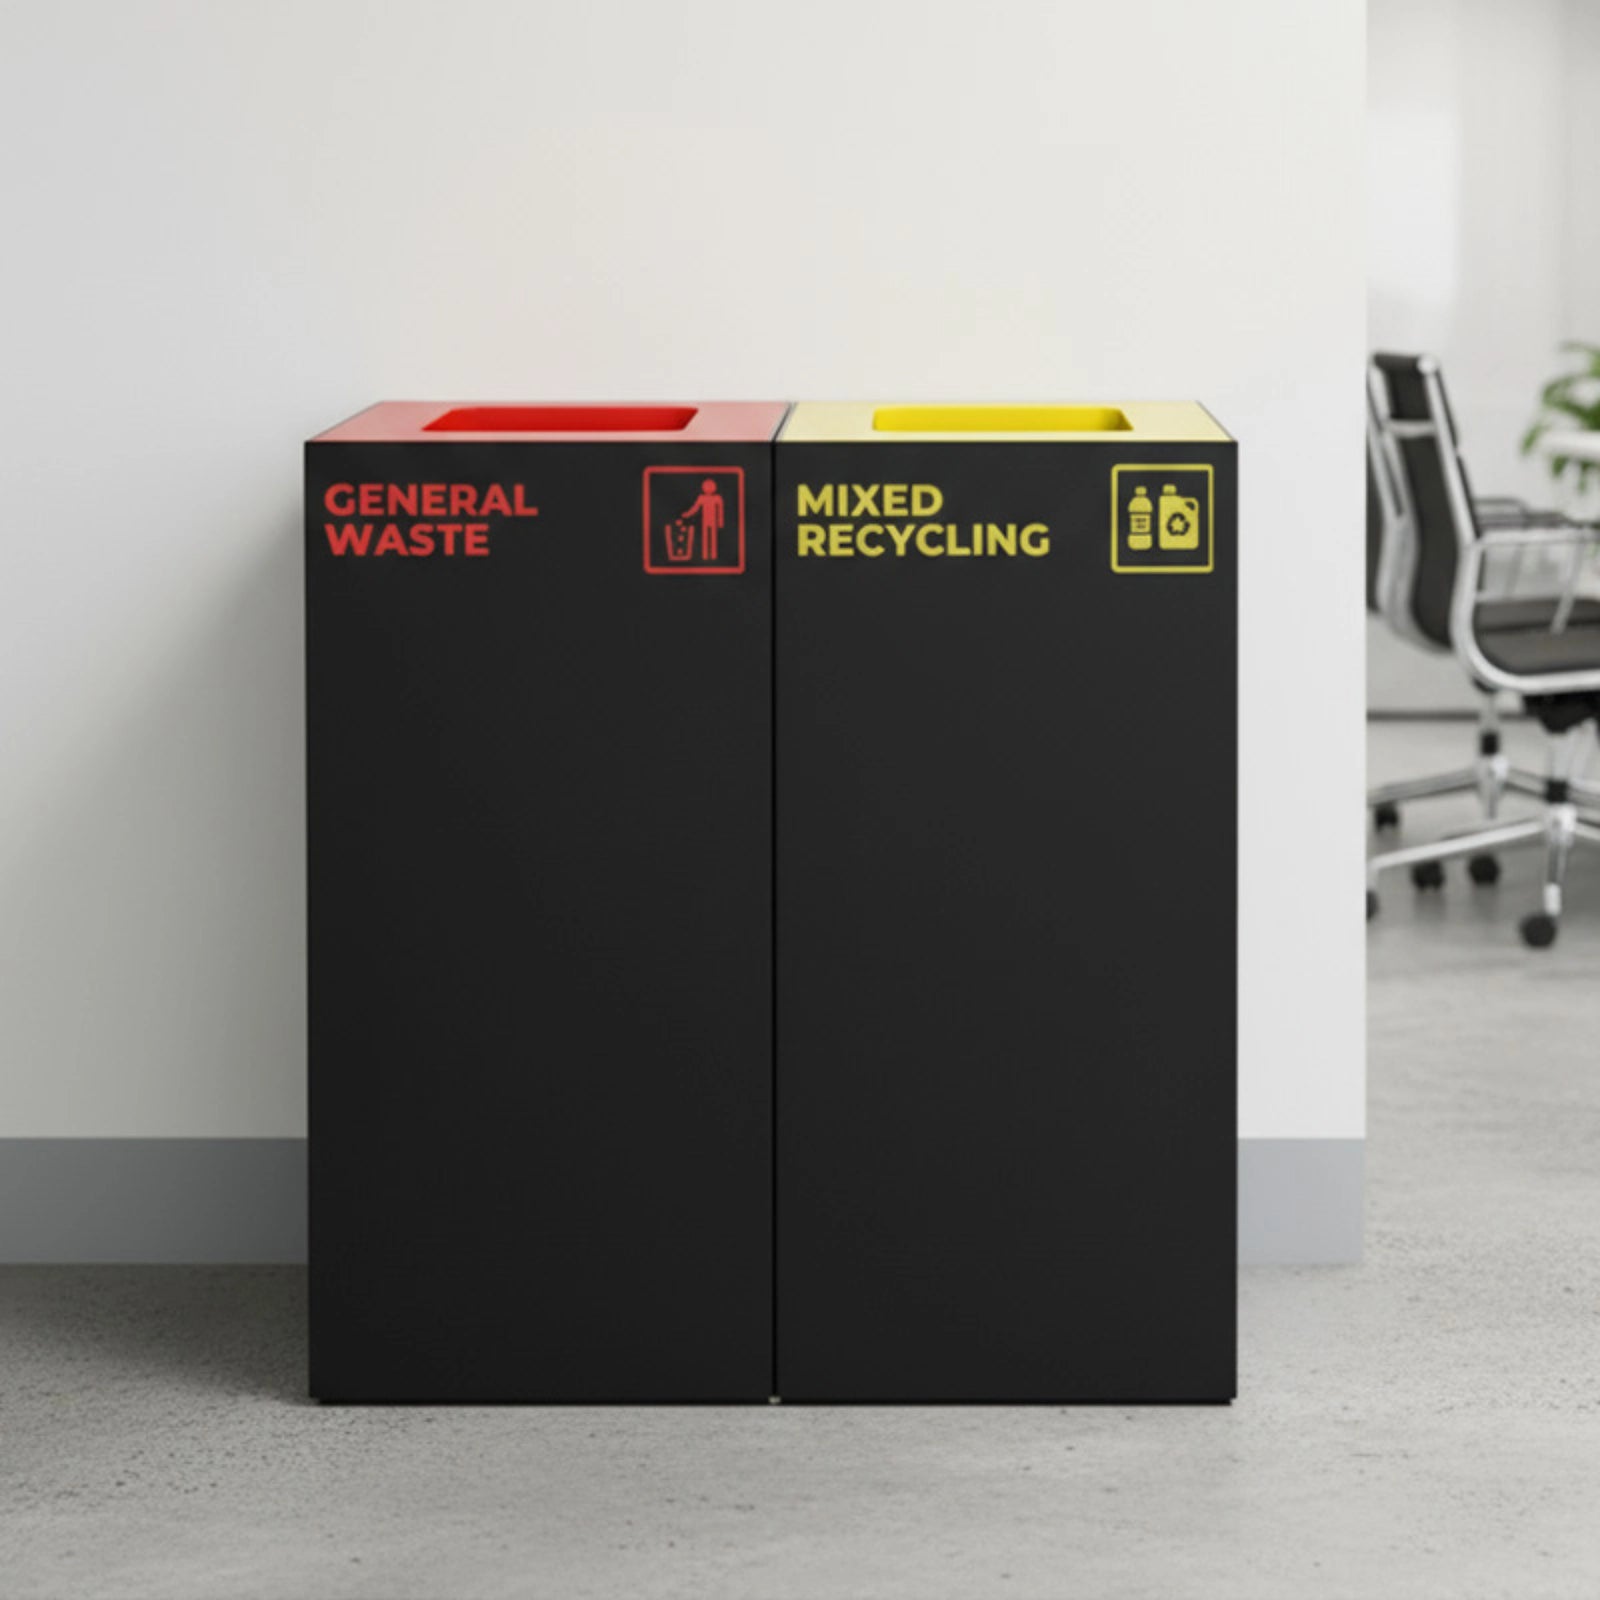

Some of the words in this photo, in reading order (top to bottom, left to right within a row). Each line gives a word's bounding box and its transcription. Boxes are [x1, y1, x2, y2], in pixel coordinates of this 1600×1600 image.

[324, 483, 538, 517] GENERAL
[797, 483, 944, 518] MIXED
[324, 523, 490, 557] WASTE
[797, 522, 1050, 557] RECYCLING
